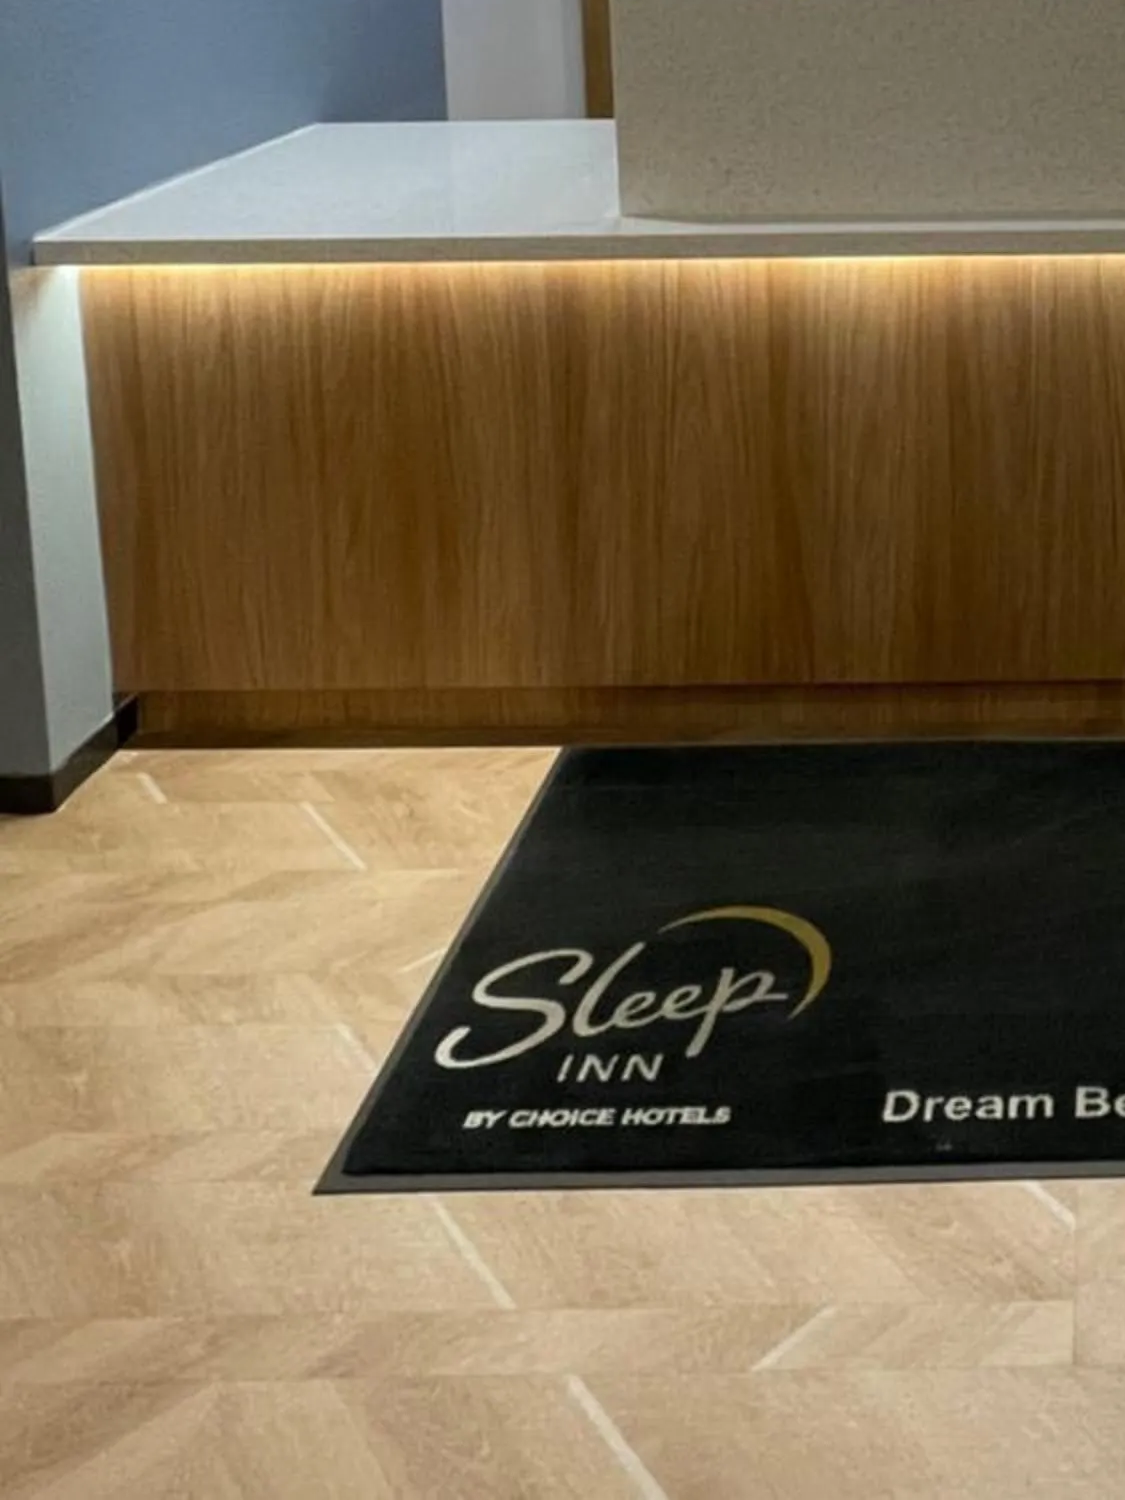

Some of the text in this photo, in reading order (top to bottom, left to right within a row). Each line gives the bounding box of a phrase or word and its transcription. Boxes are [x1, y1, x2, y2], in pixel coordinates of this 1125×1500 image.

[434, 942, 788, 1069] Sleep
[557, 1054, 663, 1082] INN
[463, 1106, 730, 1128] BY CHOICE HOTELS
[882, 1090, 1053, 1122] Dream
